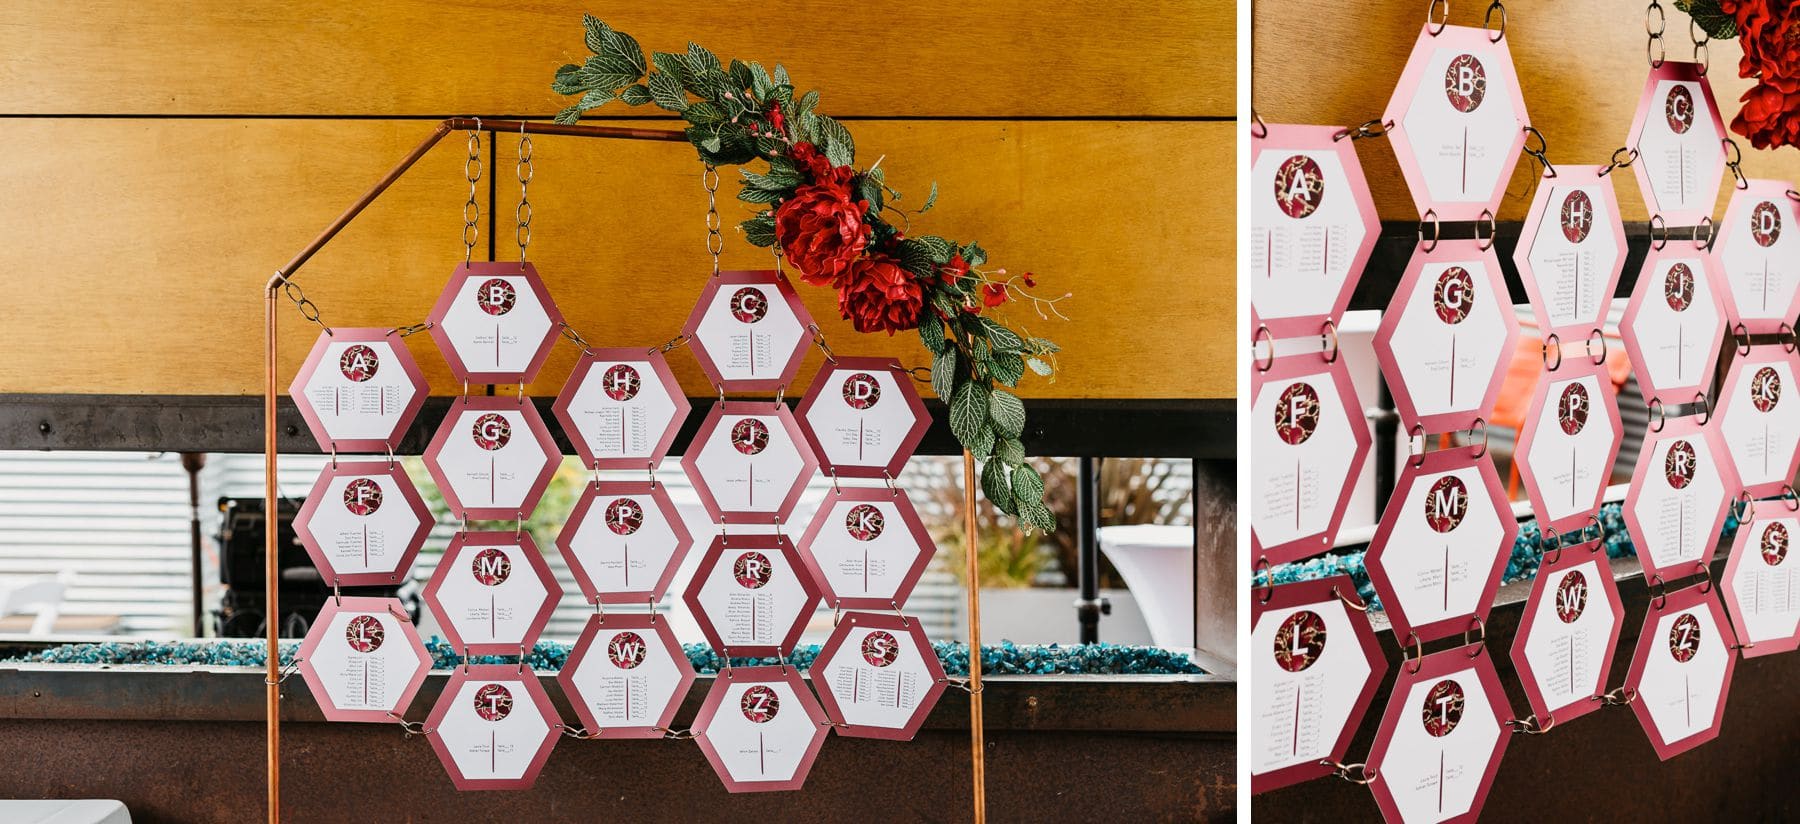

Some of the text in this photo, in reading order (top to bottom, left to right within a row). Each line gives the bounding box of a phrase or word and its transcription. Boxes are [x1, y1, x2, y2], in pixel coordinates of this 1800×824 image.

[1459, 67, 1474, 96] B
[1674, 95, 1686, 121] C
[1289, 169, 1311, 200] A
[1568, 202, 1584, 228] H
[1760, 211, 1775, 235] D
[1443, 279, 1462, 309] G
[1675, 272, 1684, 298] J
[490, 287, 503, 305] B
[741, 295, 756, 313] C
[350, 354, 368, 371] A
[614, 373, 630, 391] H
[855, 381, 872, 399] D
[1762, 375, 1775, 400] K
[1291, 395, 1308, 428] F
[1569, 394, 1580, 421] P
[482, 421, 499, 440] G
[744, 427, 754, 445] J
[1675, 451, 1687, 474] R
[358, 487, 369, 505] F
[1435, 487, 1459, 517] M
[619, 507, 631, 524] P
[860, 512, 875, 531] K
[1769, 531, 1780, 554] S
[481, 557, 502, 575] M
[747, 560, 760, 578] R
[1562, 584, 1582, 611] W
[360, 624, 371, 642] L
[1292, 625, 1307, 655] L
[1679, 624, 1691, 650] Z
[616, 643, 639, 661] W
[874, 639, 886, 658] S
[487, 695, 501, 714] T
[752, 694, 767, 712] Z
[1436, 696, 1451, 725] T
